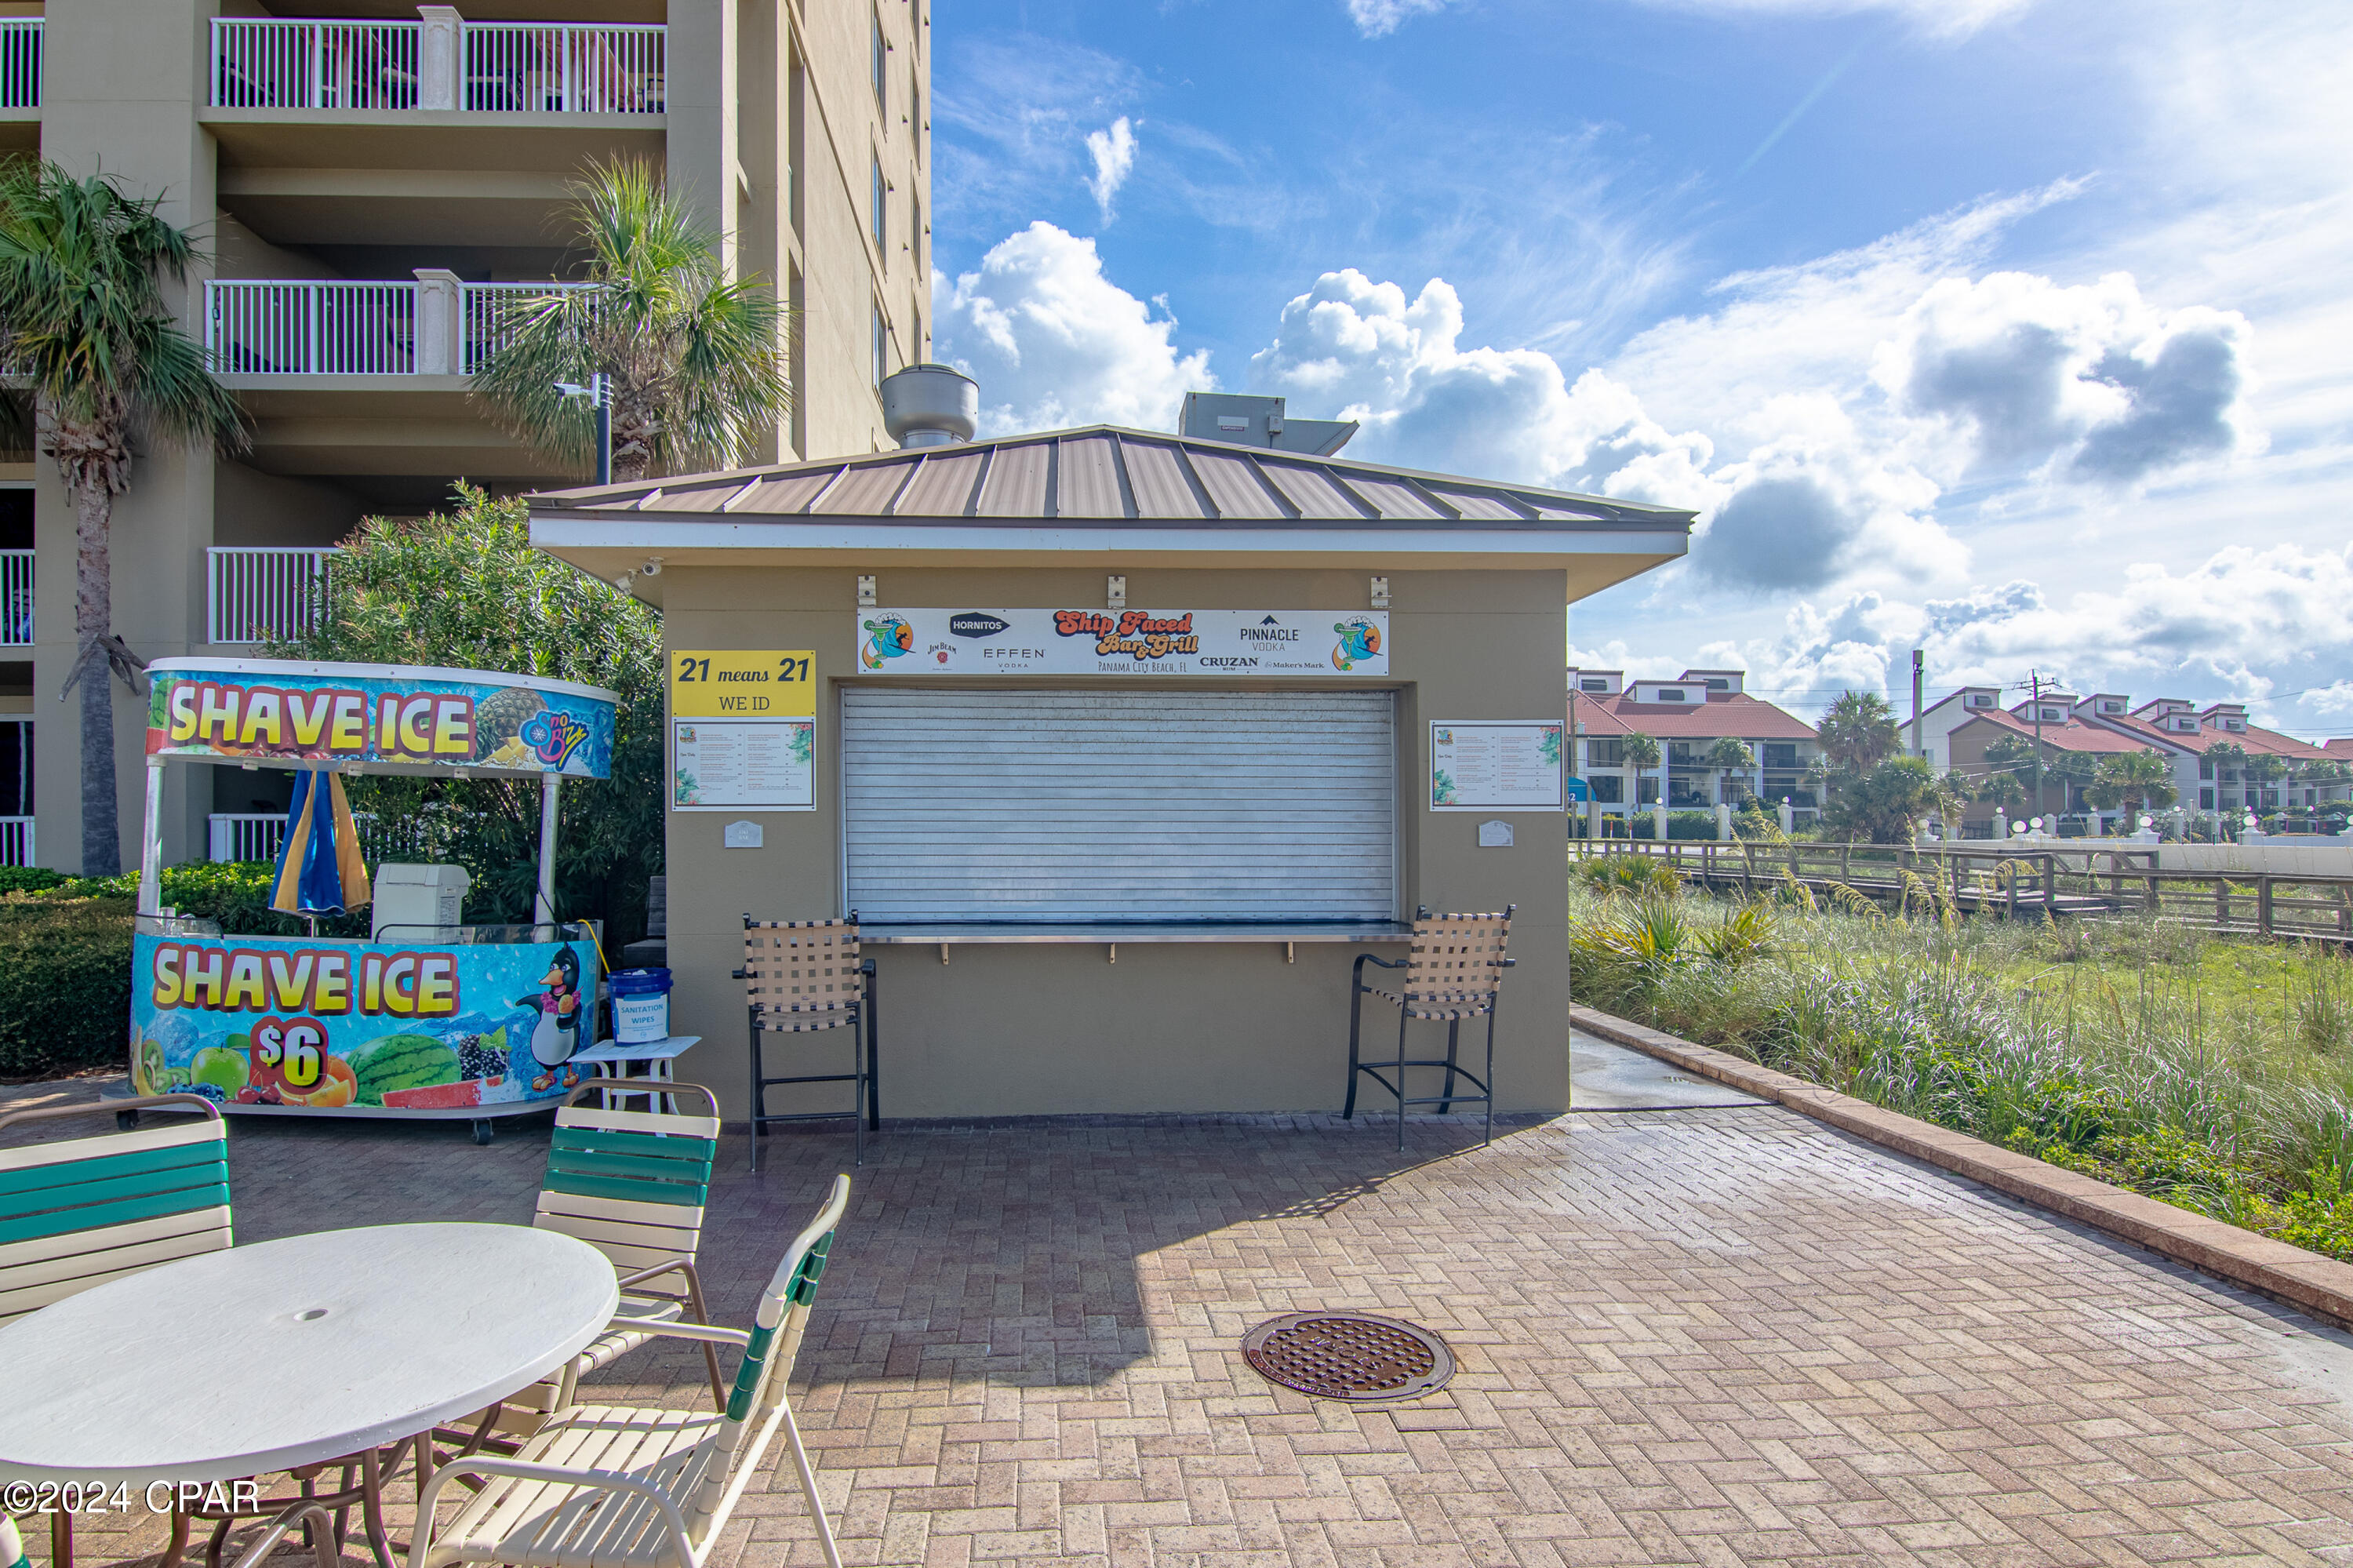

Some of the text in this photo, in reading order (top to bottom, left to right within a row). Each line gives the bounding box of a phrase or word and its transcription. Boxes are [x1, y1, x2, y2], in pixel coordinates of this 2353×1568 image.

[953, 620, 1002, 630] HORNITOS
[1054, 610, 1193, 639] Ship Faced
[1240, 628, 1299, 641] PINNACLE
[928, 642, 956, 654] JIM BEAM
[1096, 632, 1198, 660] Bar & Grill
[1252, 642, 1286, 652] VODKA
[984, 649, 1044, 658] EFFEN
[1098, 661, 1130, 672] PANAMA
[1199, 657, 1258, 667] CRUZAN
[678, 657, 809, 682] 21 means 21
[719, 697, 769, 710] WE ID
[170, 685, 470, 754] SHAVE ICE
[156, 949, 453, 1012] SHAVE ICE
[621, 1004, 664, 1013] SANITATION
[259, 1025, 320, 1086] $6
